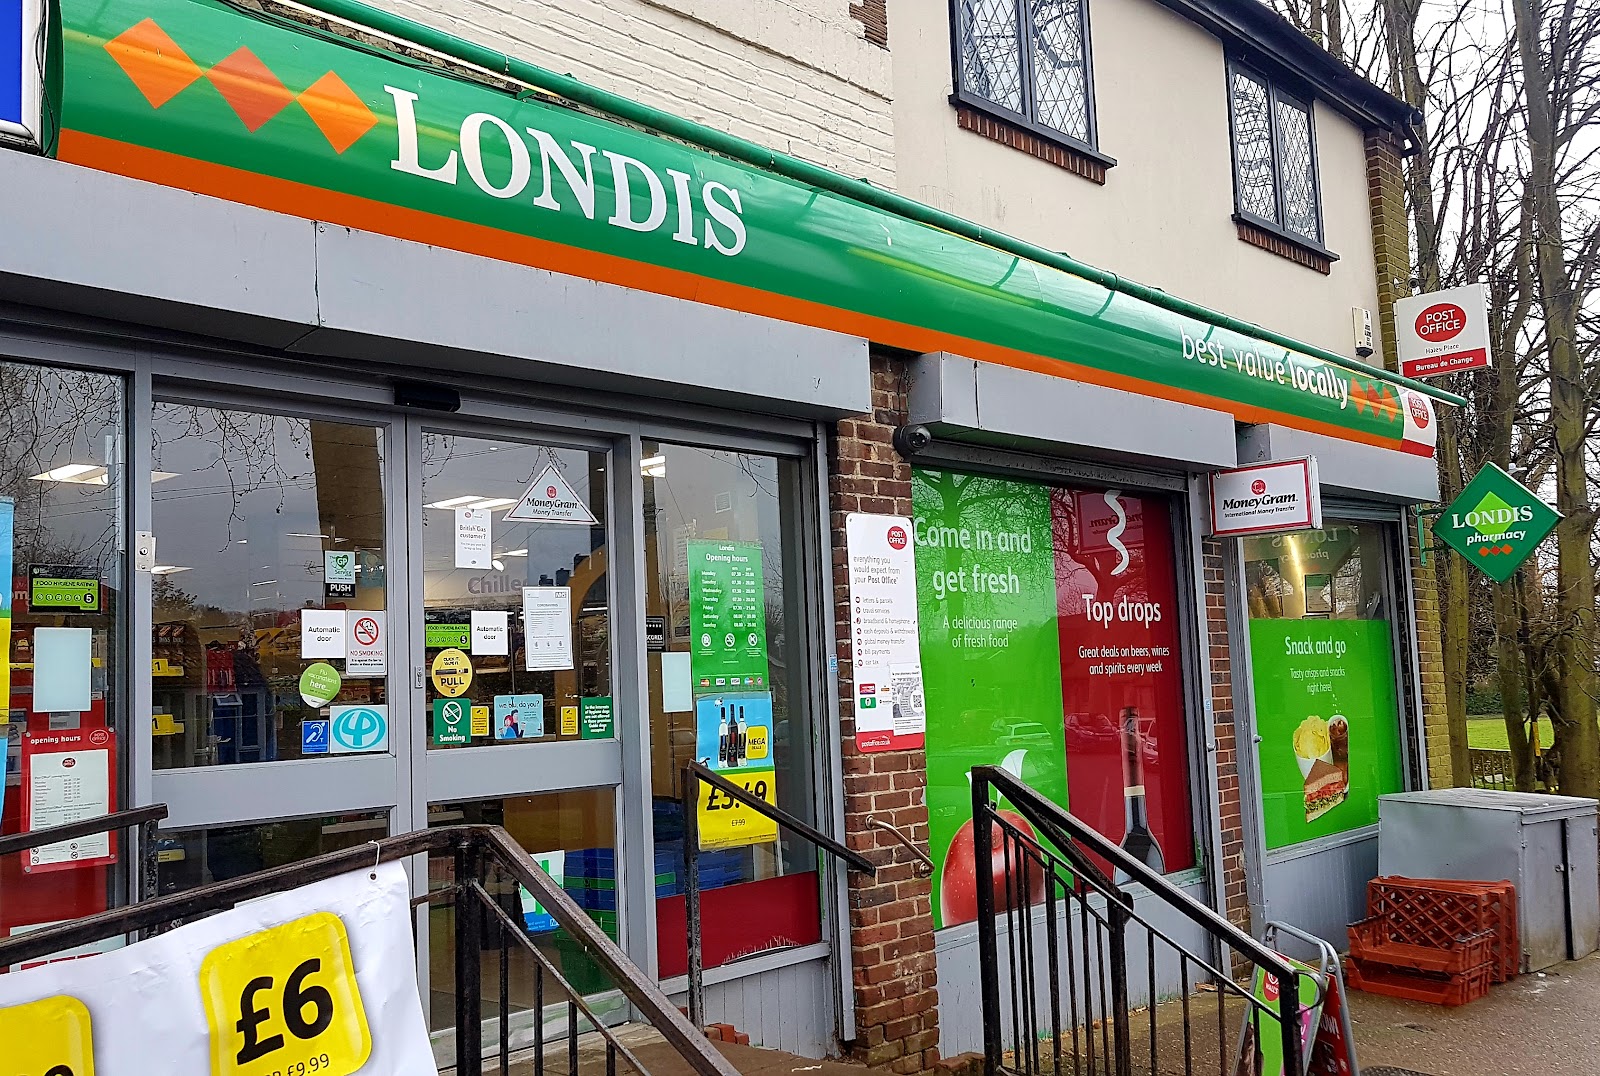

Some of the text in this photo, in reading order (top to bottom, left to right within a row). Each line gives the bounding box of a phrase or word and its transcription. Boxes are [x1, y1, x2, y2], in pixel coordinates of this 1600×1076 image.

[384, 85, 747, 256] LONDIS
[1426, 309, 1455, 323] POST
[1420, 319, 1461, 335] OFFICE
[1443, 344, 1459, 352] Place
[1180, 325, 1348, 410] best value locally
[1416, 363, 1439, 371] Bureau
[1449, 356, 1473, 366] Change
[1411, 397, 1425, 409] POST
[1411, 407, 1428, 420] OFFICE
[532, 508, 551, 516] Money
[1224, 505, 1296, 518] International Money Transfer
[1451, 505, 1534, 529] LONDIS
[889, 536, 906, 545] OFFICE
[891, 530, 904, 538] POST
[913, 517, 1032, 553] Come in and
[1466, 530, 1527, 546] pharmacy
[338, 558, 347, 566] GP
[706, 553, 748, 563] Opening hours
[853, 556, 890, 565] everything you
[871, 567, 887, 575] expect
[888, 566, 900, 574] from
[330, 584, 351, 592] PUSH
[932, 564, 1019, 600] get fresh
[86, 594, 92, 602] 5
[1082, 593, 1161, 629] Top drops
[943, 615, 1018, 632] A delicious range
[952, 634, 1008, 647] of fresh food
[1285, 636, 1346, 658] Snack and go
[1079, 645, 1099, 658] Great
[1101, 645, 1119, 657] deals
[1131, 645, 1150, 657] beers,
[1151, 645, 1170, 656] wines
[1089, 660, 1162, 677] and spirits every week
[1290, 666, 1345, 681] Tasty crisps and snacks
[308, 672, 337, 684] vaccinations
[440, 677, 464, 686] PULL
[1307, 681, 1332, 695] right here!
[527, 700, 539, 709] you?
[30, 736, 59, 745] opening
[235, 958, 334, 1065] £6
[287, 1054, 329, 1076] £9.99
